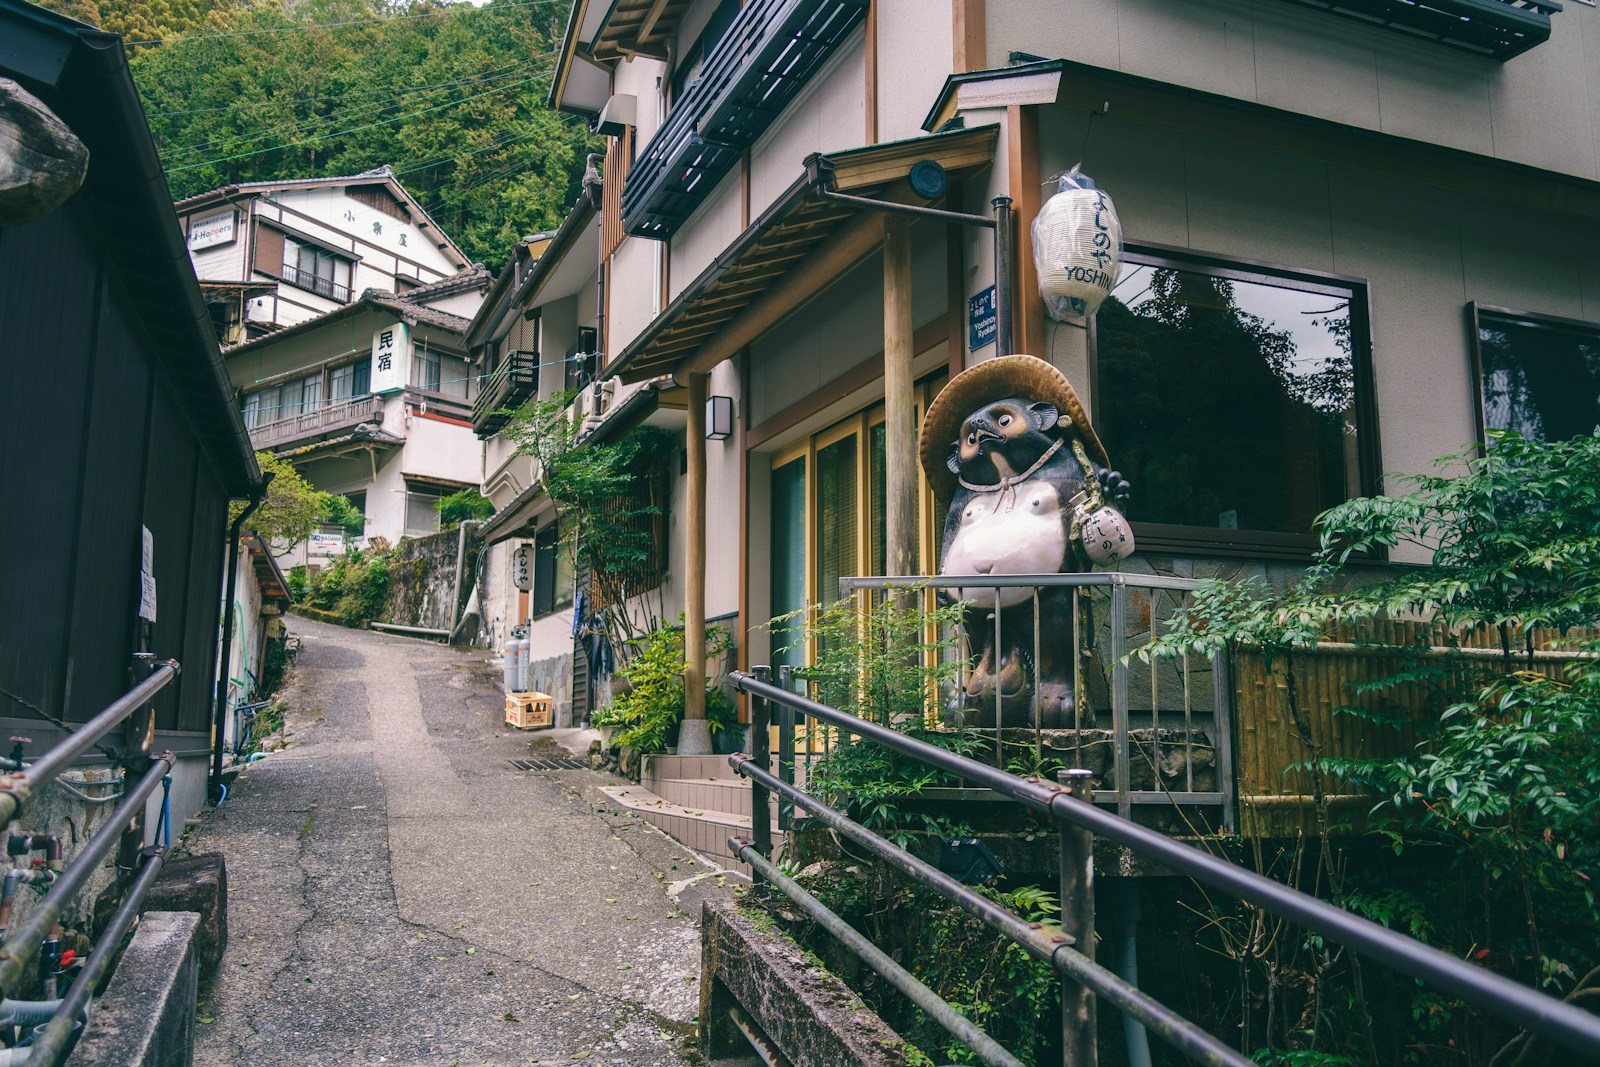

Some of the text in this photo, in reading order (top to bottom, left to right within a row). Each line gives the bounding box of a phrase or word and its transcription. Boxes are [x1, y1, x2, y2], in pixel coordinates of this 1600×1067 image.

[1091, 192, 1112, 269] よしのや
[377, 330, 394, 373] 民宿
[1091, 514, 1119, 562] よしのや
[518, 549, 529, 584] よしのや
